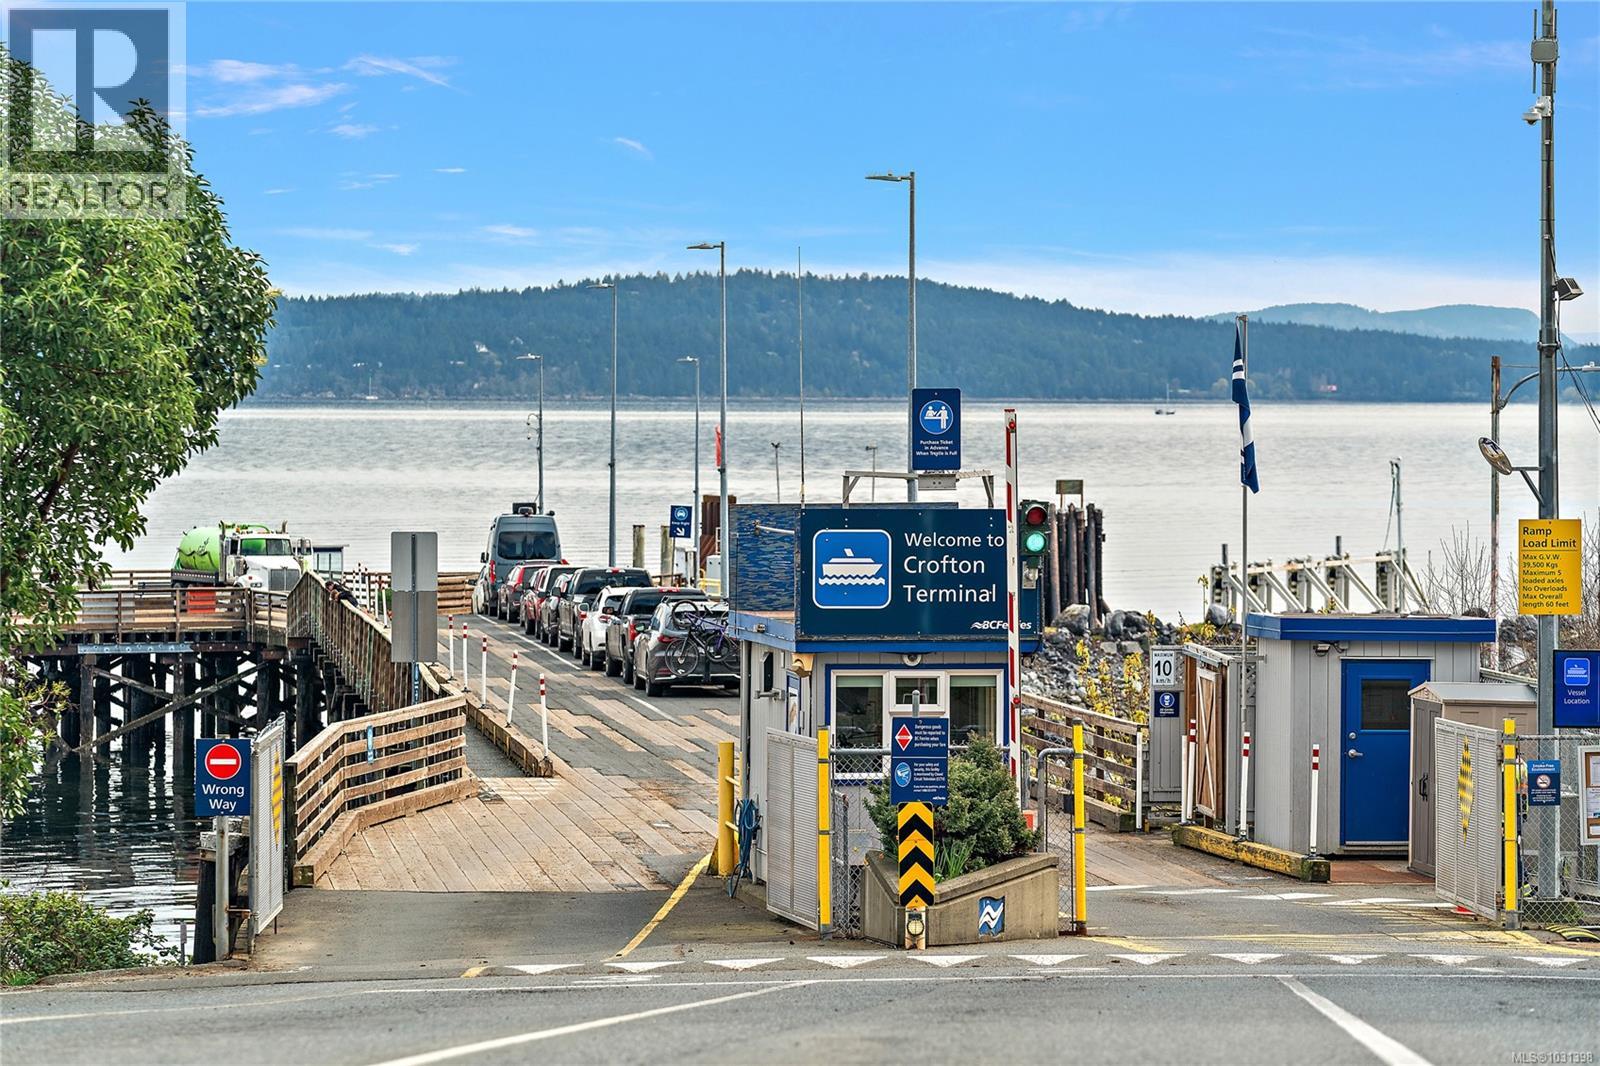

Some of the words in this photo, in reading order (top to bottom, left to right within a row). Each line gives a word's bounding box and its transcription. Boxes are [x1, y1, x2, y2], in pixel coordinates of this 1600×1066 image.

[1522, 526, 1552, 537] Ramp
[904, 531, 982, 547] Welcome
[987, 533, 1005, 547] to
[1522, 538, 1547, 548] Load
[1551, 538, 1577, 548] Limit
[904, 554, 985, 574] Crofton
[902, 583, 996, 603] Terminal
[1522, 601, 1544, 609] length
[1154, 660, 1172, 676] 10
[1563, 697, 1591, 705] Location
[201, 783, 245, 798] Wrong
[209, 798, 237, 812] Way
